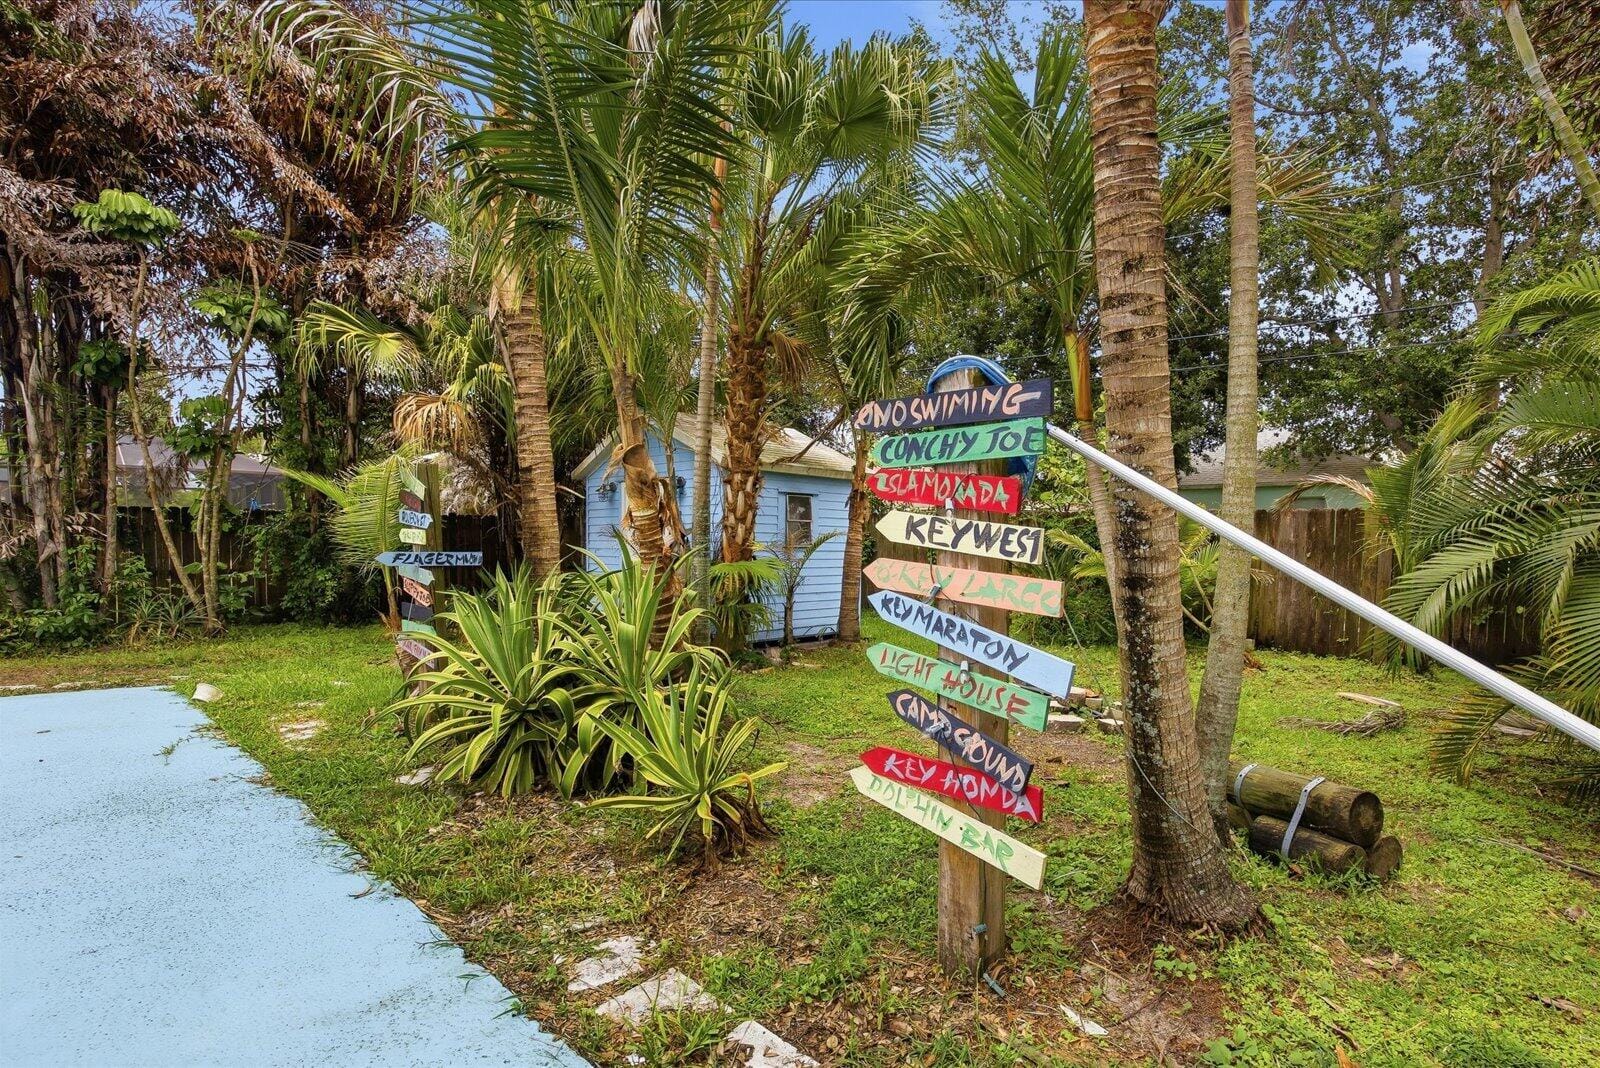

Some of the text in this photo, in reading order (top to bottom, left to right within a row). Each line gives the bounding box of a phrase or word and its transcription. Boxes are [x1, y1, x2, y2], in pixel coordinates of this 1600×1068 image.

[880, 426, 1045, 465] CONCHY JOE
[879, 648, 1031, 716] LIGHT HOUSE
[884, 753, 1039, 823] KEY HONDA
[867, 774, 1015, 873] DOLPHIN BAR
